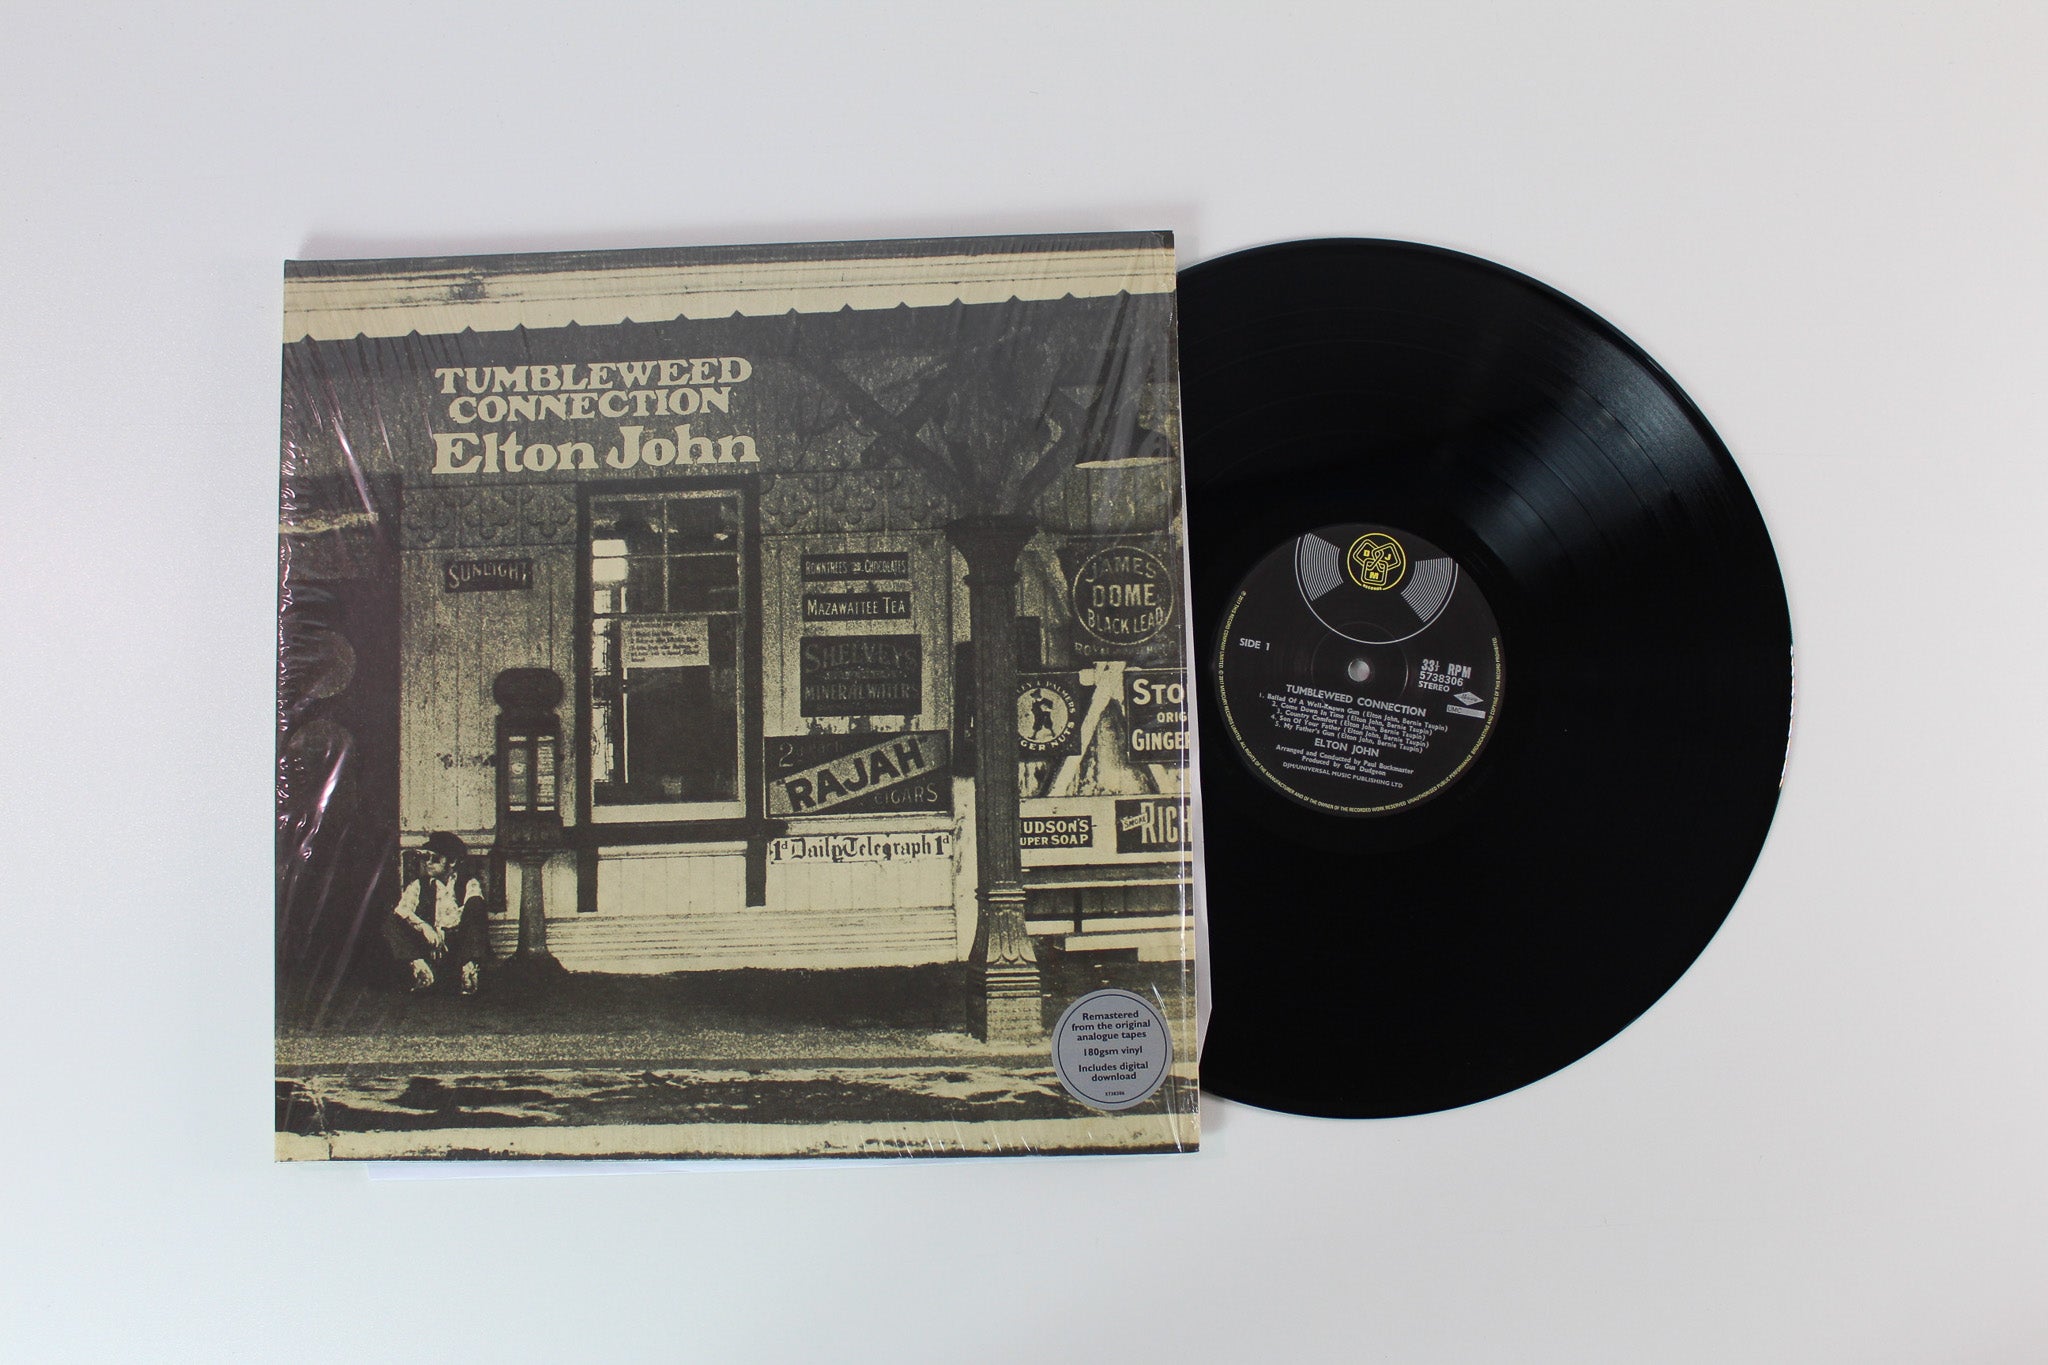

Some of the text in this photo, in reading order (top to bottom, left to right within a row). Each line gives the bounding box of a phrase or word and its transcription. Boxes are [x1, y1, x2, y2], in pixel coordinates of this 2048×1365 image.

[435, 356, 752, 394] TUMBLEWEED
[449, 386, 731, 424] CONNECTION
[431, 423, 760, 474] Elton John
[448, 562, 527, 589] SUNLIGHT
[1085, 556, 1157, 583] JAMES
[807, 596, 906, 616] MAZAWATTEE TEA
[1093, 583, 1156, 608] DOME
[1087, 606, 1164, 634] BLACK LEAD
[1239, 638, 1270, 650] SIDE 1
[1419, 671, 1463, 686] 5738306
[1447, 663, 1471, 678] RPM
[1133, 679, 1187, 705] STO
[1418, 680, 1449, 692] STEREO
[1287, 684, 1426, 716] TUMBLEWEED CONNECTION
[1157, 711, 1188, 724] ORIG
[1267, 693, 1286, 701] Ballad
[1402, 718, 1421, 726] Bernie
[1424, 721, 1448, 732] Taupin)
[1280, 702, 1297, 710] Come
[1300, 706, 1318, 714] Down
[1386, 722, 1406, 730] Bernie
[1409, 725, 1432, 736] Taupin)
[1283, 722, 1293, 730] My
[1295, 724, 1320, 734] Father's
[1377, 739, 1396, 748] Bernie
[1399, 743, 1422, 753] Taupin)
[1285, 710, 1309, 719] Country
[1312, 714, 1337, 724] Comfort
[1379, 727, 1399, 735] Bernie
[1402, 730, 1425, 741] Taupin)
[1304, 719, 1319, 727] Your
[1321, 723, 1341, 731] Father
[1383, 734, 1403, 742] Bernie
[1406, 738, 1429, 748] Taupin)
[1276, 744, 1304, 754] Arranged
[1319, 752, 1351, 763] Conducted
[1353, 758, 1361, 766] by
[1379, 762, 1413, 774] Buckmaster
[1314, 738, 1379, 757] ELTON JOHN
[785, 738, 925, 812] RAJAH
[1301, 755, 1330, 765] Produced
[1359, 766, 1386, 776] Dudgeon
[1352, 774, 1389, 785] PUBLISHING
[874, 782, 939, 806] CIGARS
[791, 837, 843, 863] Daily
[843, 835, 932, 862] Telegraph
[1051, 834, 1090, 846] SOAP
[1071, 1019, 1151, 1031] from the original
[1082, 1010, 1139, 1021] Remastered
[1077, 1030, 1147, 1042] analogue tapes
[1083, 1046, 1143, 1058] 180gsm vinyl
[1078, 1061, 1149, 1073] Includes digital
[1091, 1072, 1137, 1082] download
